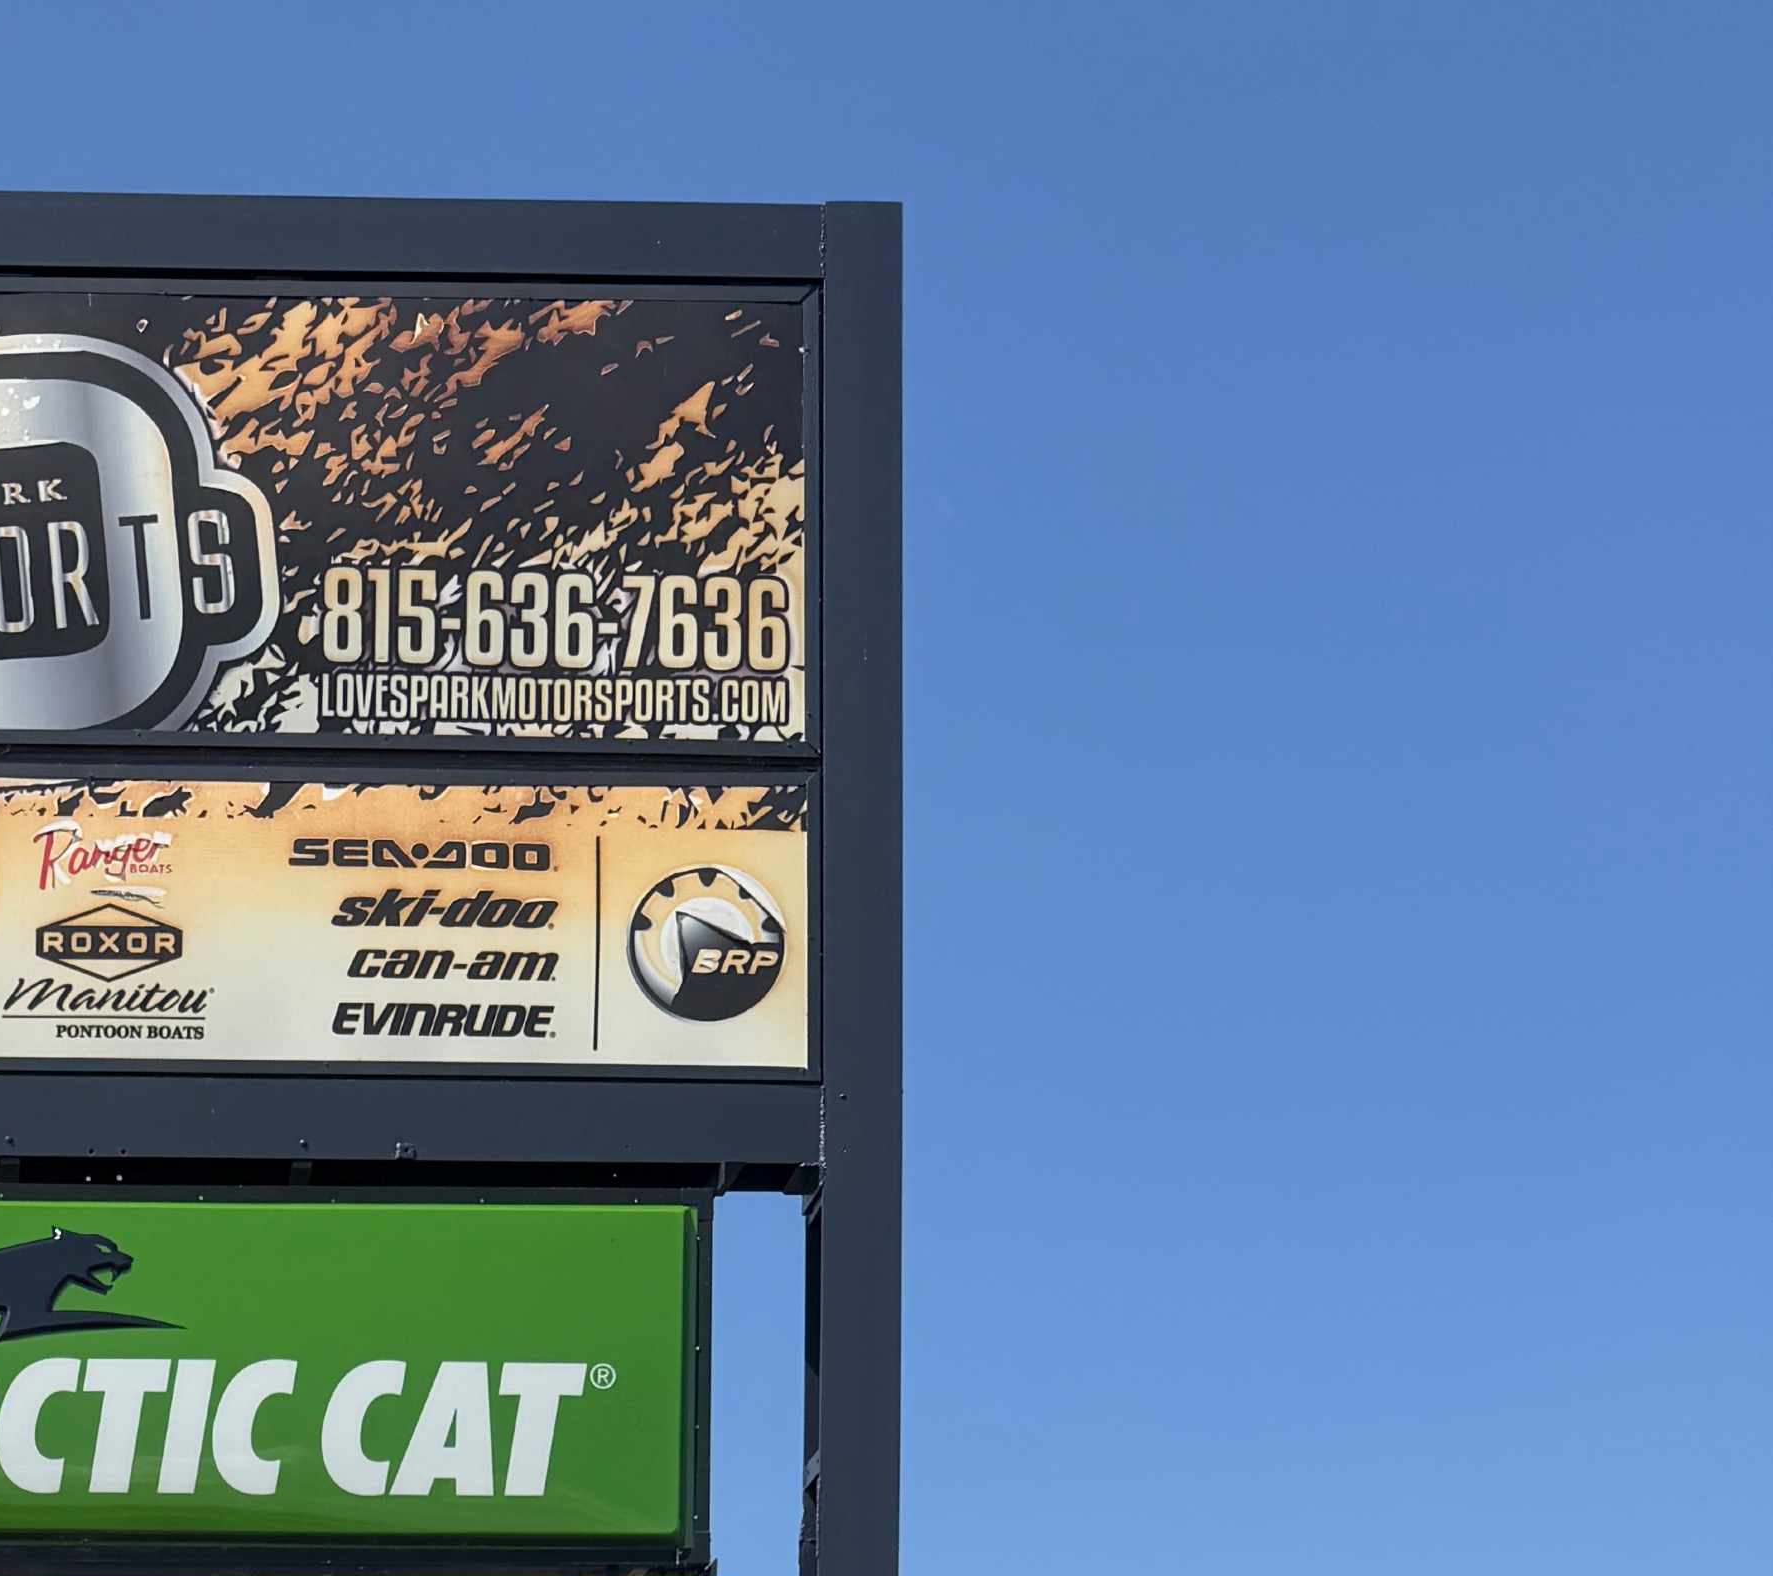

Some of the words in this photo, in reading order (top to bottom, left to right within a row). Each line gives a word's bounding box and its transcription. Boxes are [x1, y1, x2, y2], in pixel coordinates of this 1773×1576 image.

[325, 566, 790, 670] 815-636-7636
[321, 672, 786, 725] LOVESPARKMOTORSPORTS.COM
[32, 821, 173, 889] Ranger
[129, 863, 173, 874] BOATS
[331, 888, 559, 929] ski-doo
[42, 931, 177, 954] ROXOR
[347, 947, 559, 981] can-am
[691, 948, 779, 975] BRP
[2, 977, 211, 1014] Manitou
[55, 1024, 144, 1039] PONTOON
[146, 1025, 205, 1040] BOATS
[332, 1001, 556, 1038] EVINRUDE
